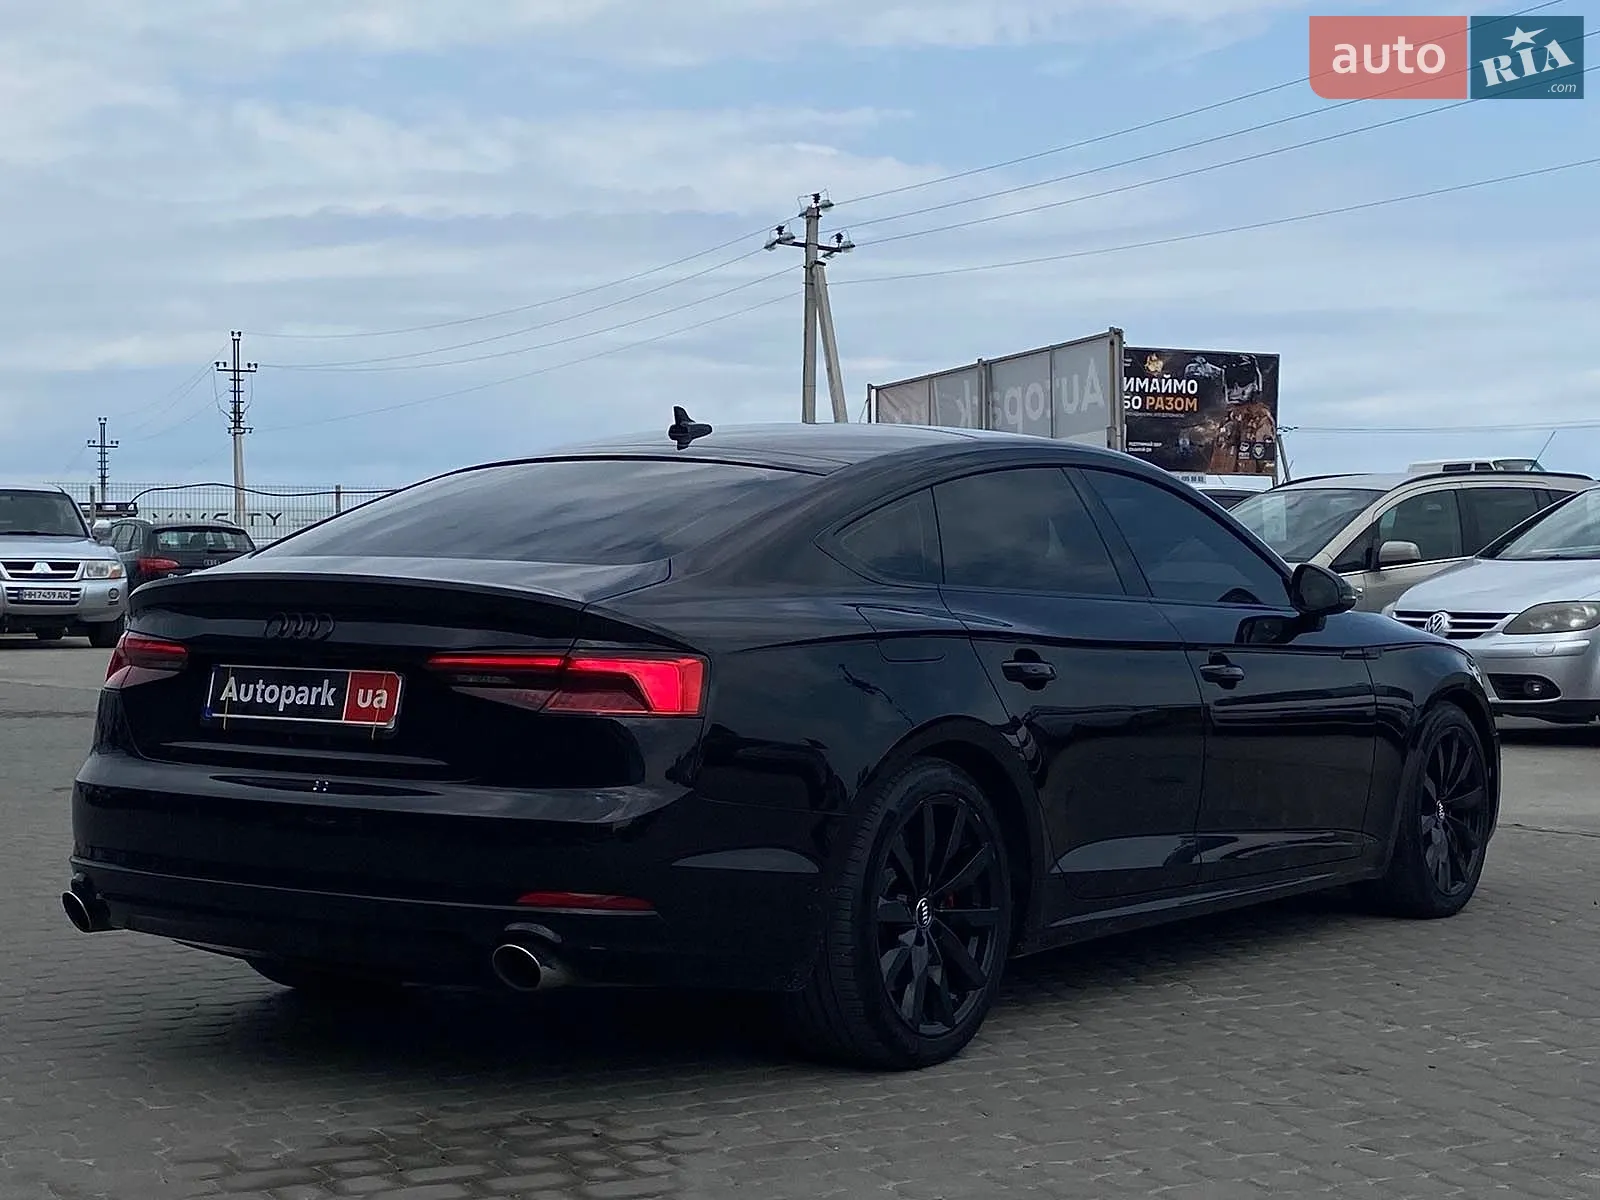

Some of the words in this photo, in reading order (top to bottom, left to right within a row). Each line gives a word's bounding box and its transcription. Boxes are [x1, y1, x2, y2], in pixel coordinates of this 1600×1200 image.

[1145, 396, 1198, 412] РАЗОМ
[219, 676, 337, 711] Autopark
[356, 687, 389, 709] ua
